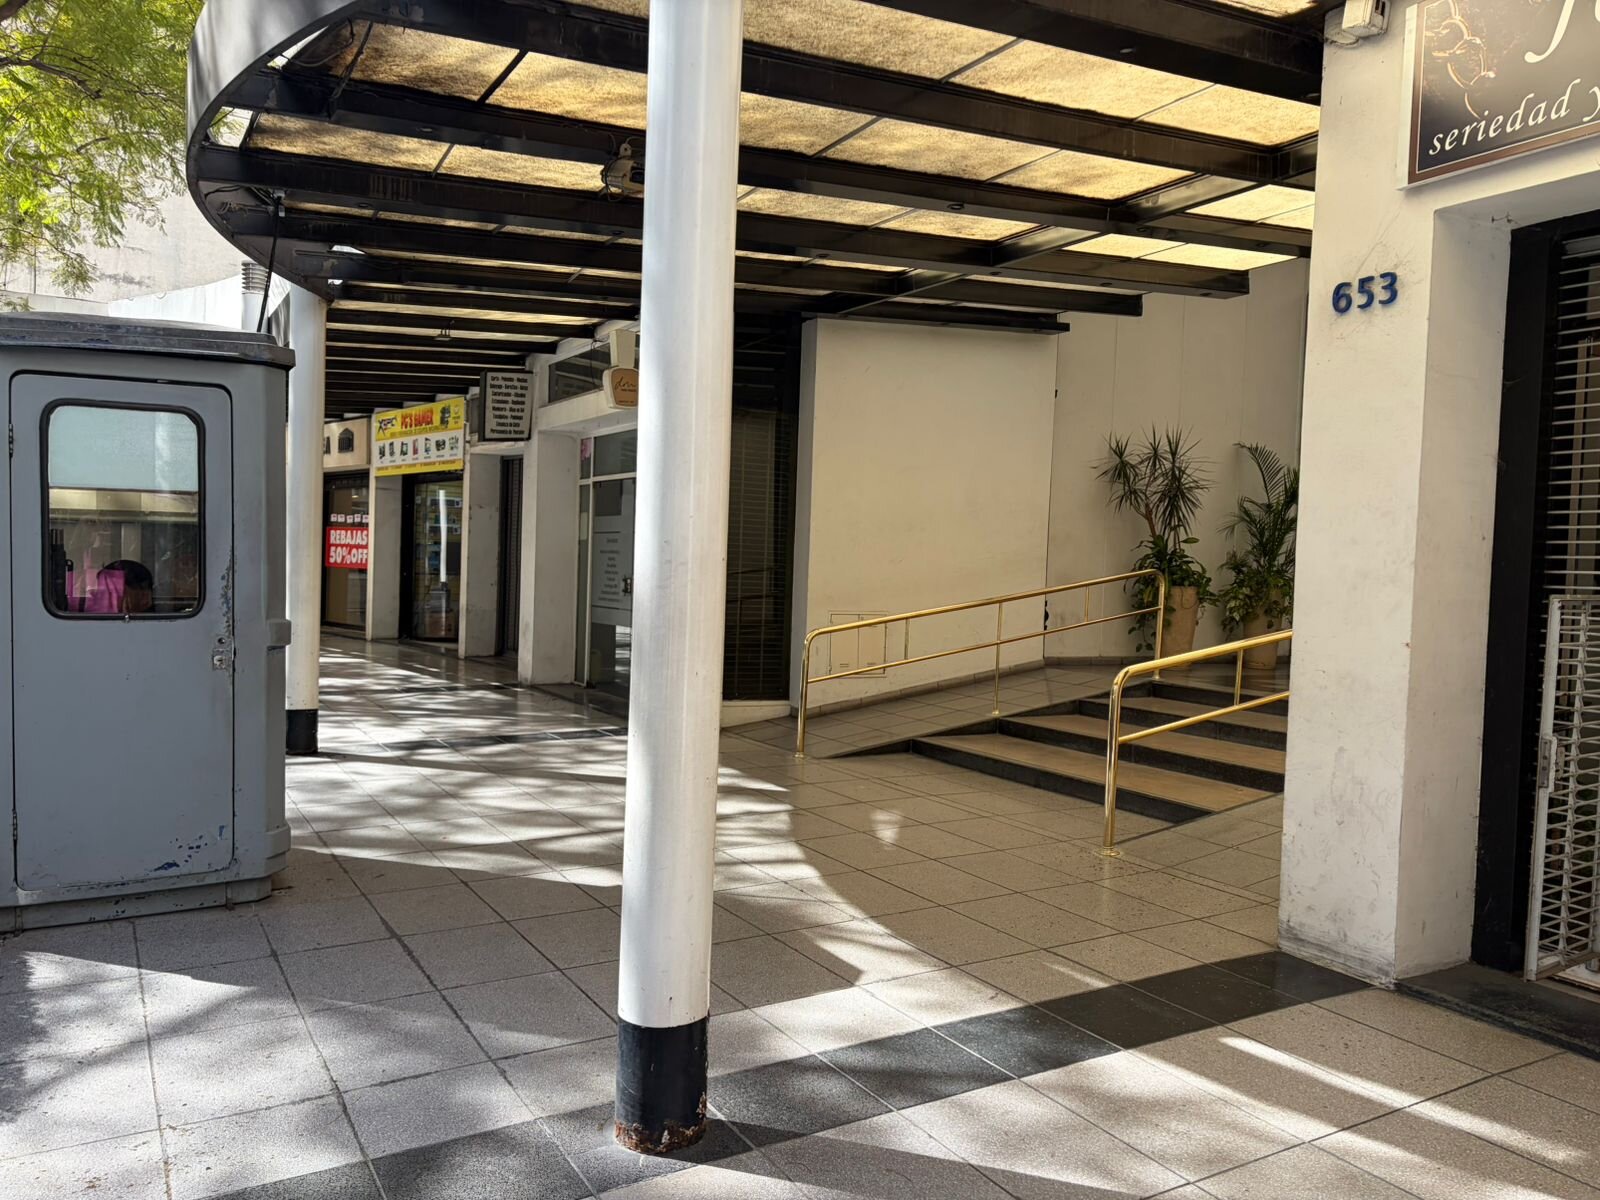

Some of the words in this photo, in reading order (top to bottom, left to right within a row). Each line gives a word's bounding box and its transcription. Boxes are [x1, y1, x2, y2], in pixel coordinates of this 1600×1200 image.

[1428, 78, 1581, 156] seriedad
[1331, 271, 1399, 314] 653
[329, 529, 368, 545] REBAJAS
